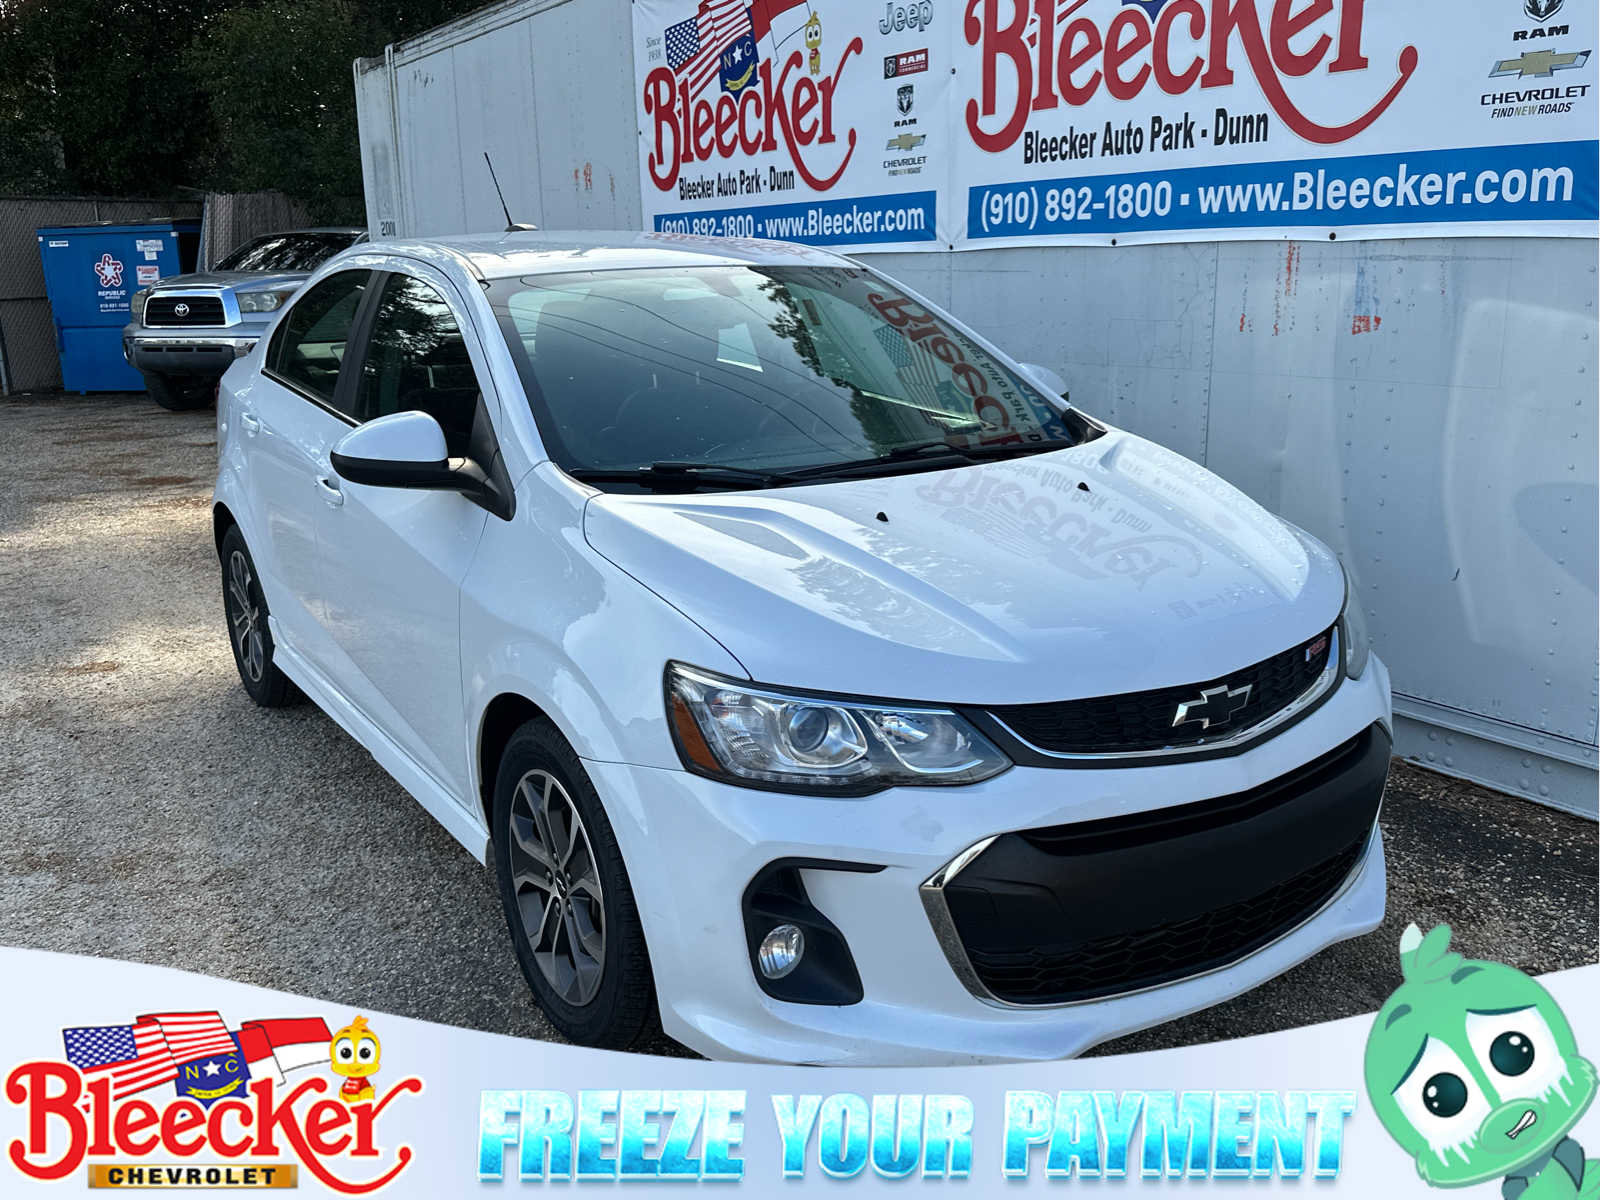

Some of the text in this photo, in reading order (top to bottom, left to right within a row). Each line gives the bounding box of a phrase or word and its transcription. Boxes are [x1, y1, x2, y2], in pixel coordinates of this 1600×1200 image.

[879, 0, 933, 35] Jeep
[1513, 24, 1569, 41] RAM
[899, 53, 926, 66] RAM
[963, 0, 1418, 153] Bleecker
[1480, 84, 1591, 106] CHEVROLET
[644, 37, 863, 191] Bleecker
[894, 117, 917, 128] RAM
[1024, 108, 1269, 165] Bleecker Auto Park Dunn
[883, 155, 928, 169] CHEVROLET
[679, 165, 795, 201] Bleecker Auto Park Dunn
[980, 163, 1574, 231] (910) 892-1800 www.Bleecker.com
[692, 214, 754, 239] 892-1800
[765, 205, 926, 239] www.Bleecker.com
